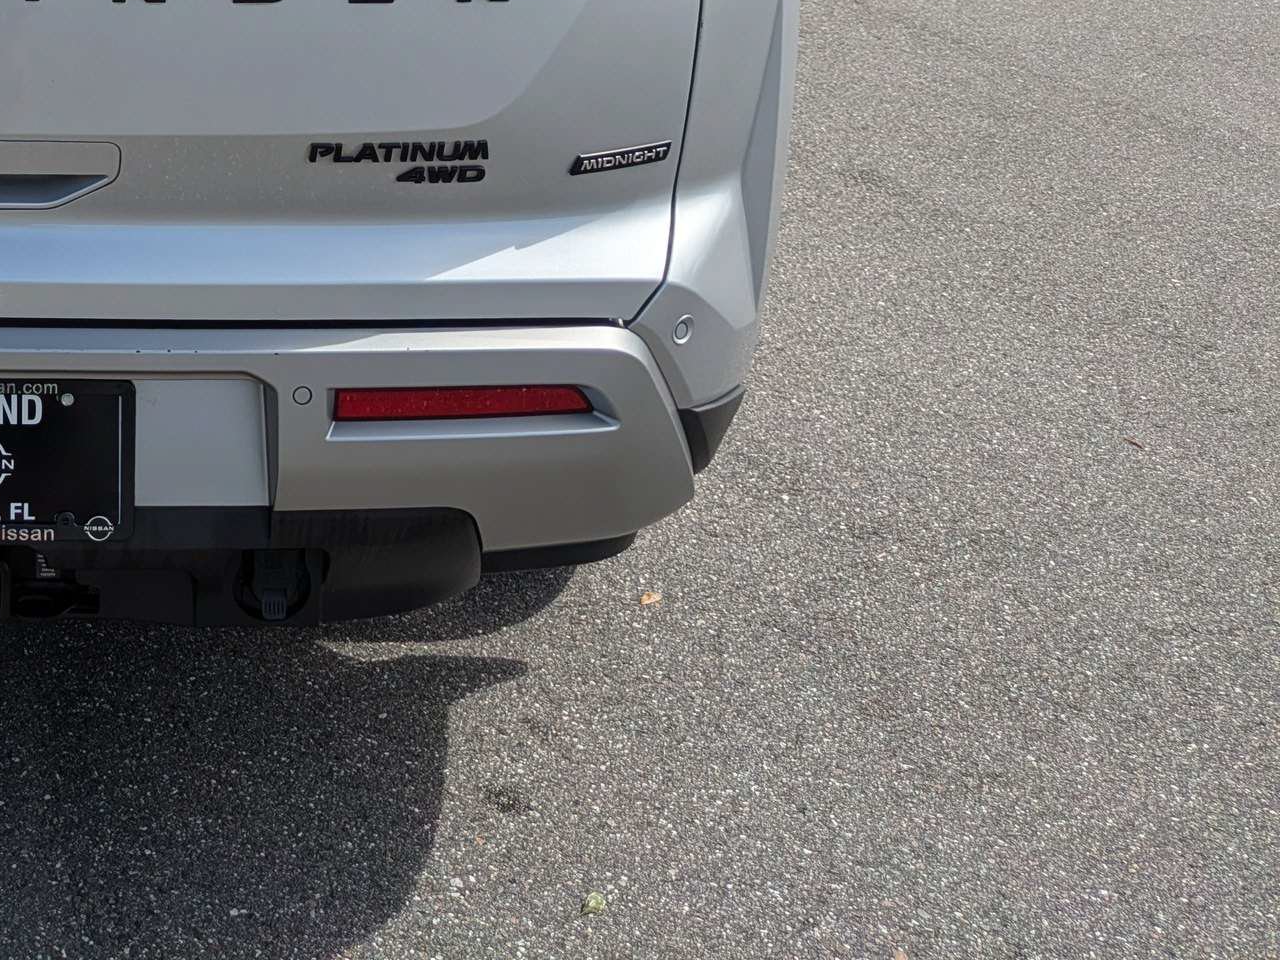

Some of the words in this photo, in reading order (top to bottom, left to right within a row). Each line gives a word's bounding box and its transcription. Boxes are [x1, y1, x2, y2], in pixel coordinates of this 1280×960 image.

[309, 140, 489, 163] PLATINUM
[580, 146, 668, 171] MIDNIGHT
[395, 165, 486, 184] 4WD
[10, 503, 36, 521] FL
